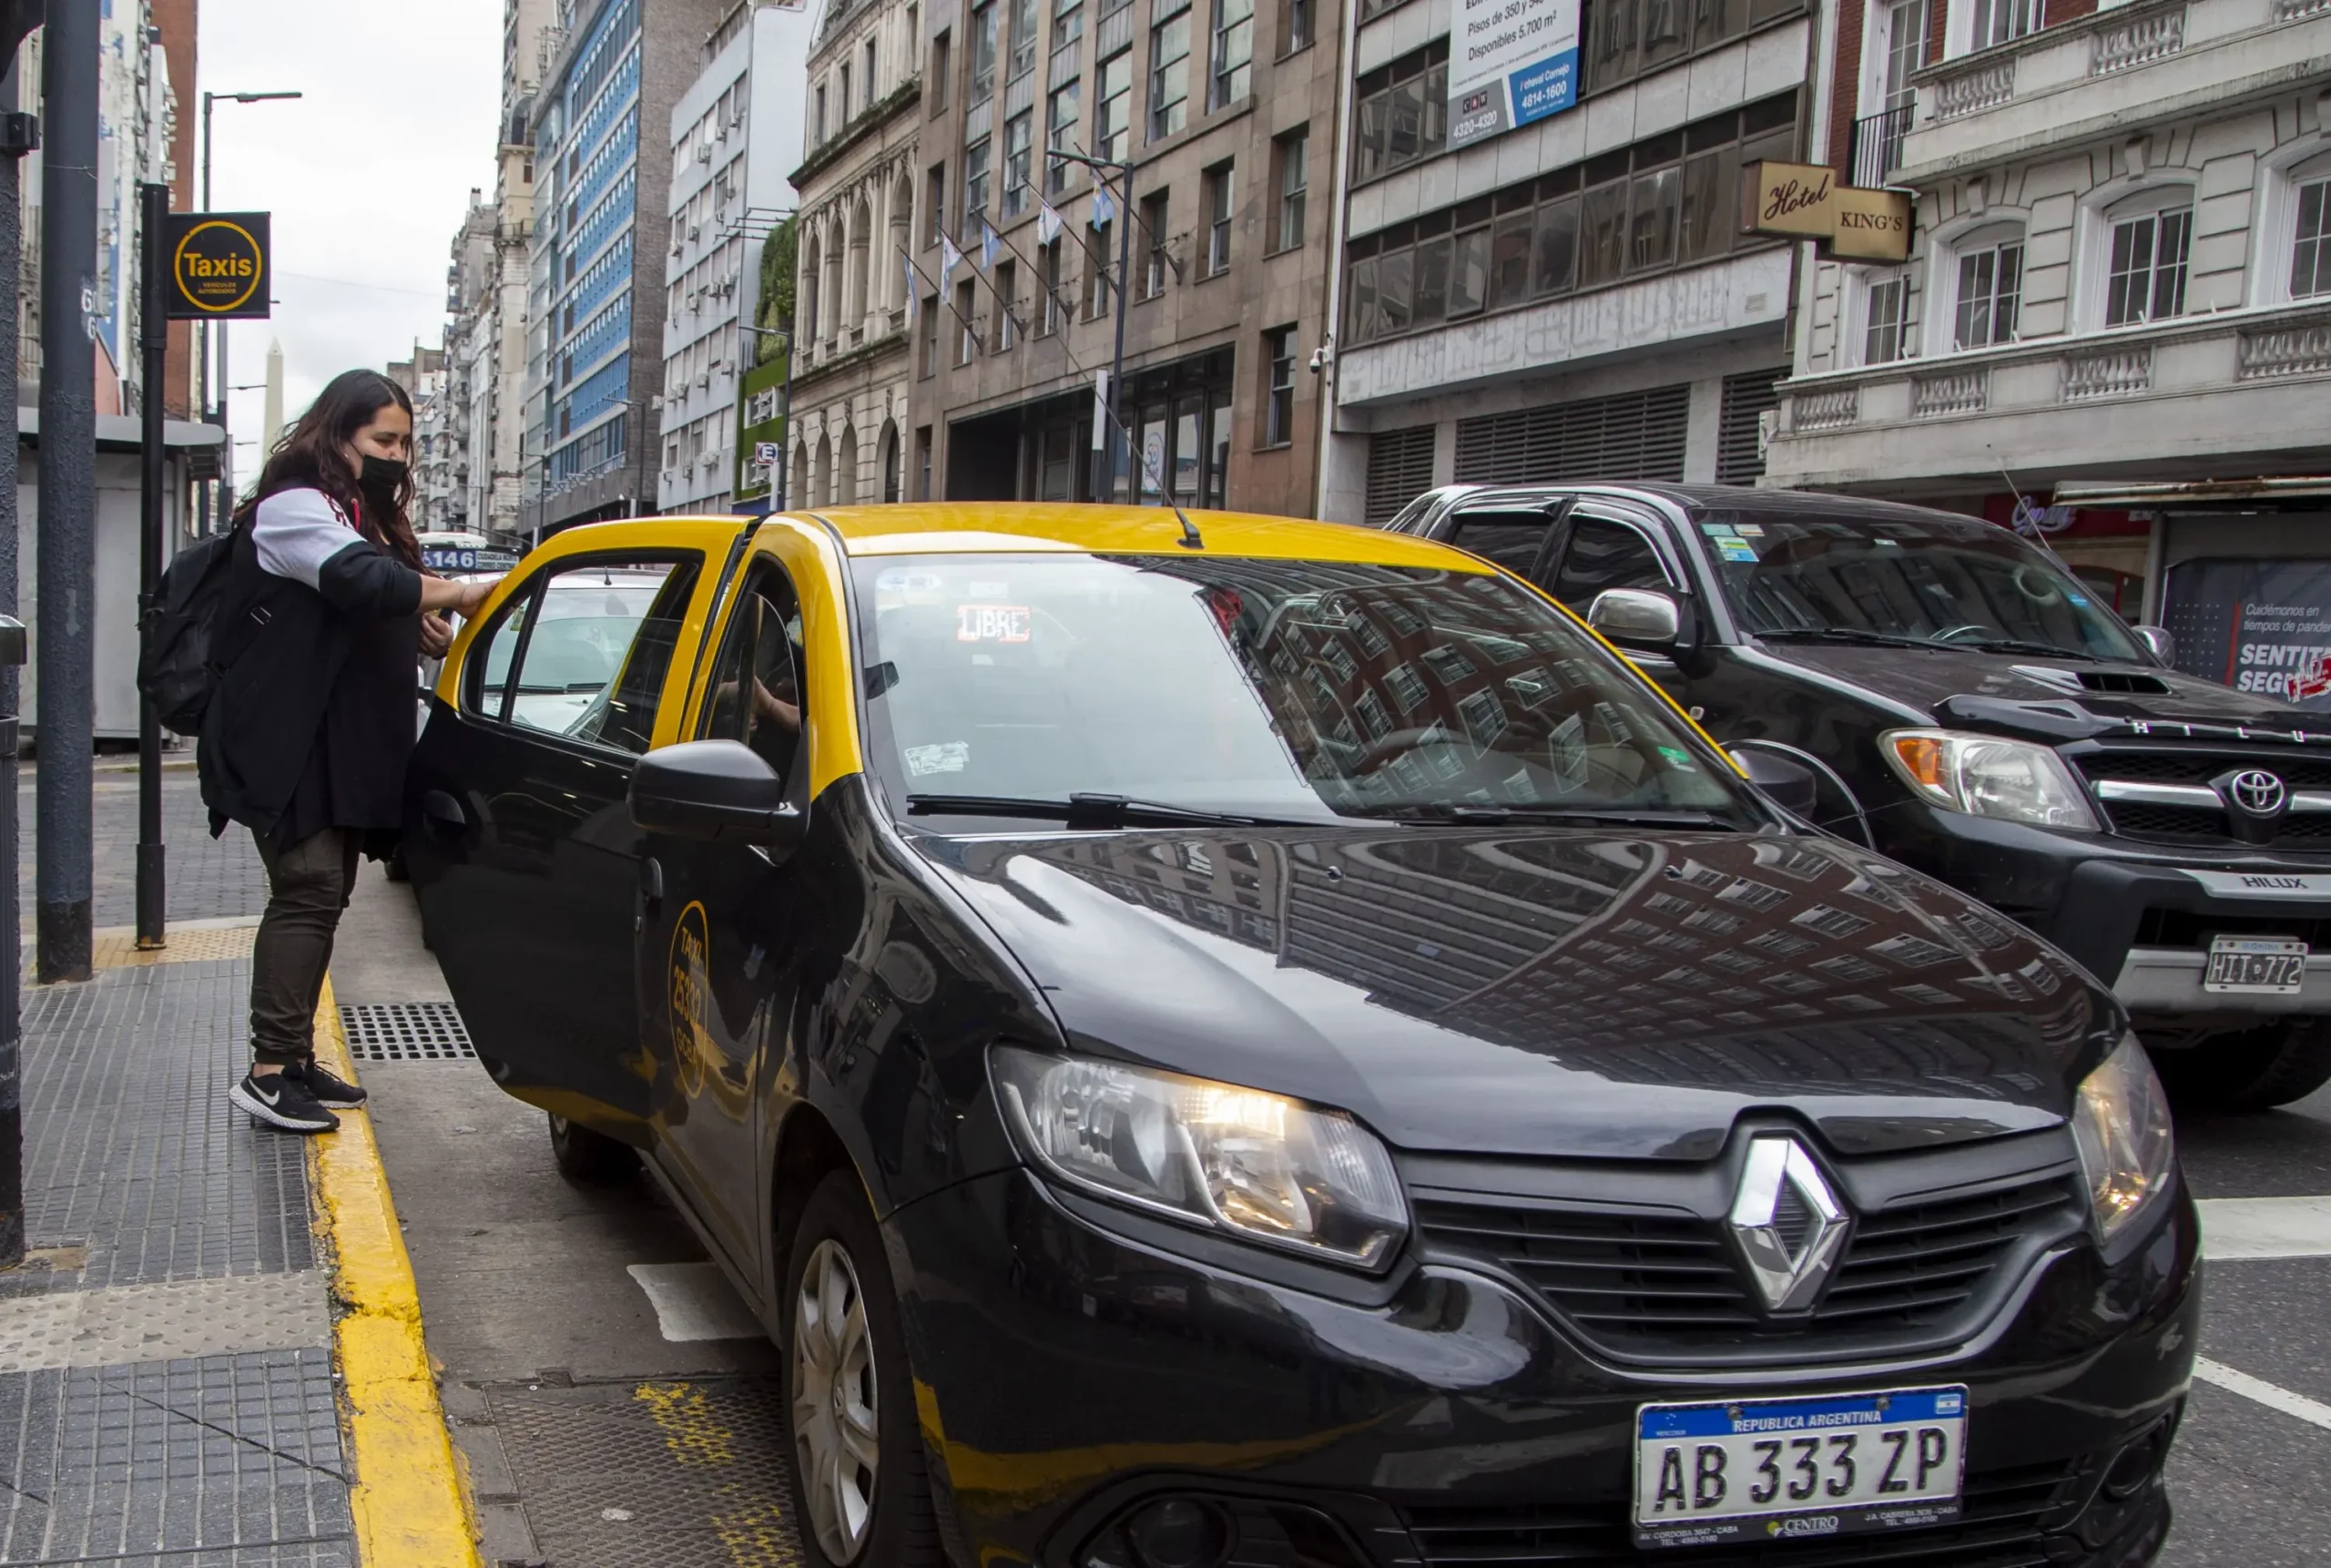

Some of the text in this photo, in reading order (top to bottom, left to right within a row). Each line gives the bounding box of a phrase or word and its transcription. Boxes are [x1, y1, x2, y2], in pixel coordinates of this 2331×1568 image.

[1468, 17, 1491, 36] Pisos
[1492, 11, 1502, 25] de
[1504, 1, 1520, 20] 350
[1522, 1, 1527, 15] y
[1469, 30, 1517, 61] Disponibles
[1519, 16, 1542, 38] 5.700
[1544, 63, 1570, 80] Cornejo
[1522, 80, 1567, 108] 4814-1600
[1453, 110, 1498, 139] 4320-4320
[1764, 173, 1828, 220] Hotel
[1840, 211, 1903, 231] KING'S
[184, 252, 252, 277] Taxis
[433, 551, 474, 568] 146
[2245, 604, 2319, 616] Cuidémonos en
[962, 608, 1025, 639] LIBRE
[2244, 619, 2281, 634] tiempos
[2283, 620, 2295, 631] de
[2240, 643, 2331, 667] SENTIT
[2241, 876, 2308, 889] HILUX
[681, 926, 702, 968] TAXI
[2264, 956, 2303, 984] 772
[1733, 1410, 1882, 1433] REPUBLICA ARGENTINA
[1654, 1426, 1949, 1512] AB 333 ZP
[1785, 1515, 1838, 1532] CENTRO
